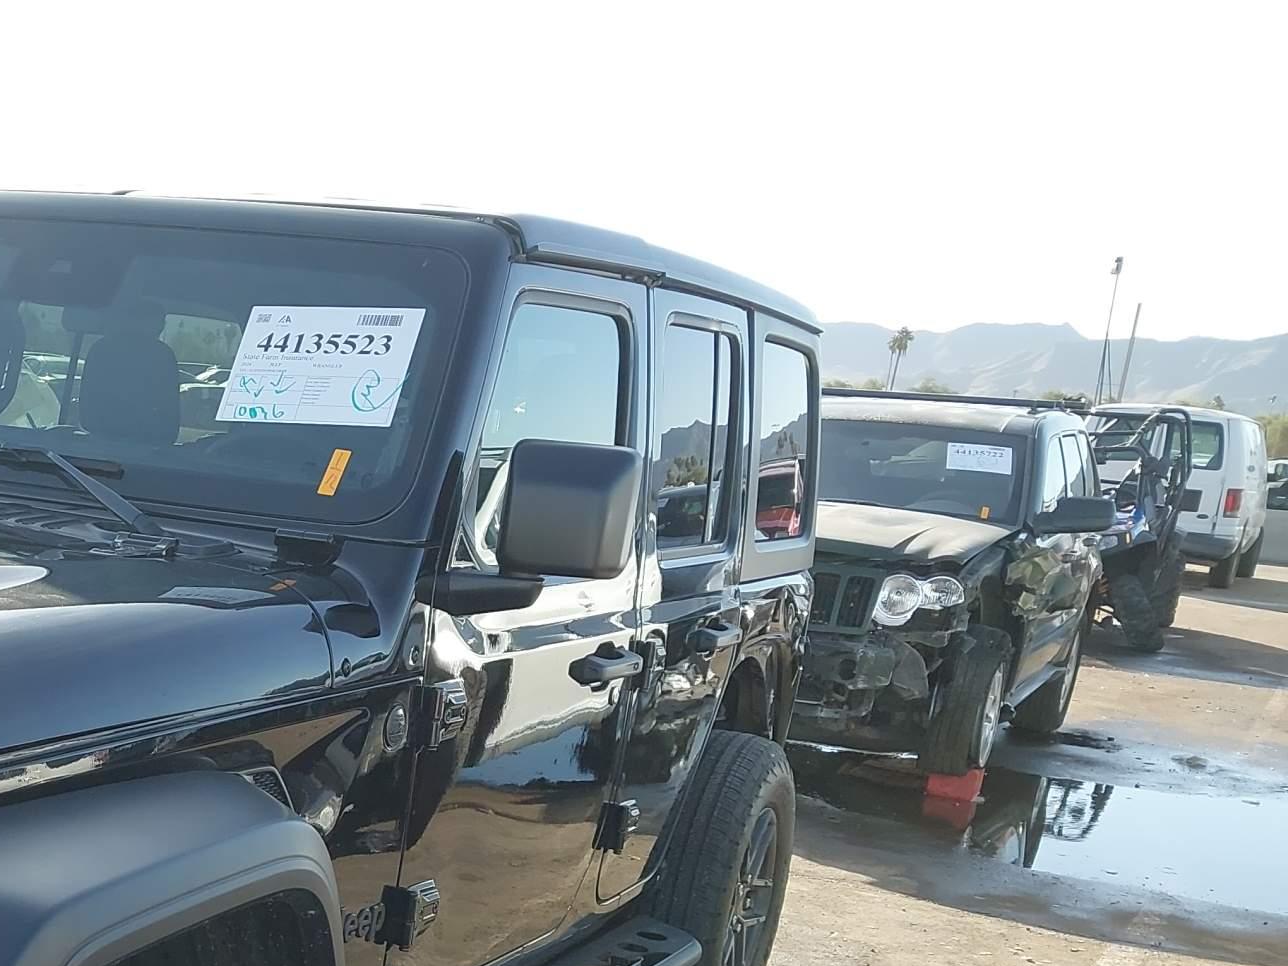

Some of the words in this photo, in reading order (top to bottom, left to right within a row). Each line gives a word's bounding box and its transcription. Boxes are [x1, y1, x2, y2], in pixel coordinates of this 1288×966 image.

[256, 332, 394, 356] 44135523
[261, 353, 280, 361] Farm
[341, 902, 386, 943] eep
